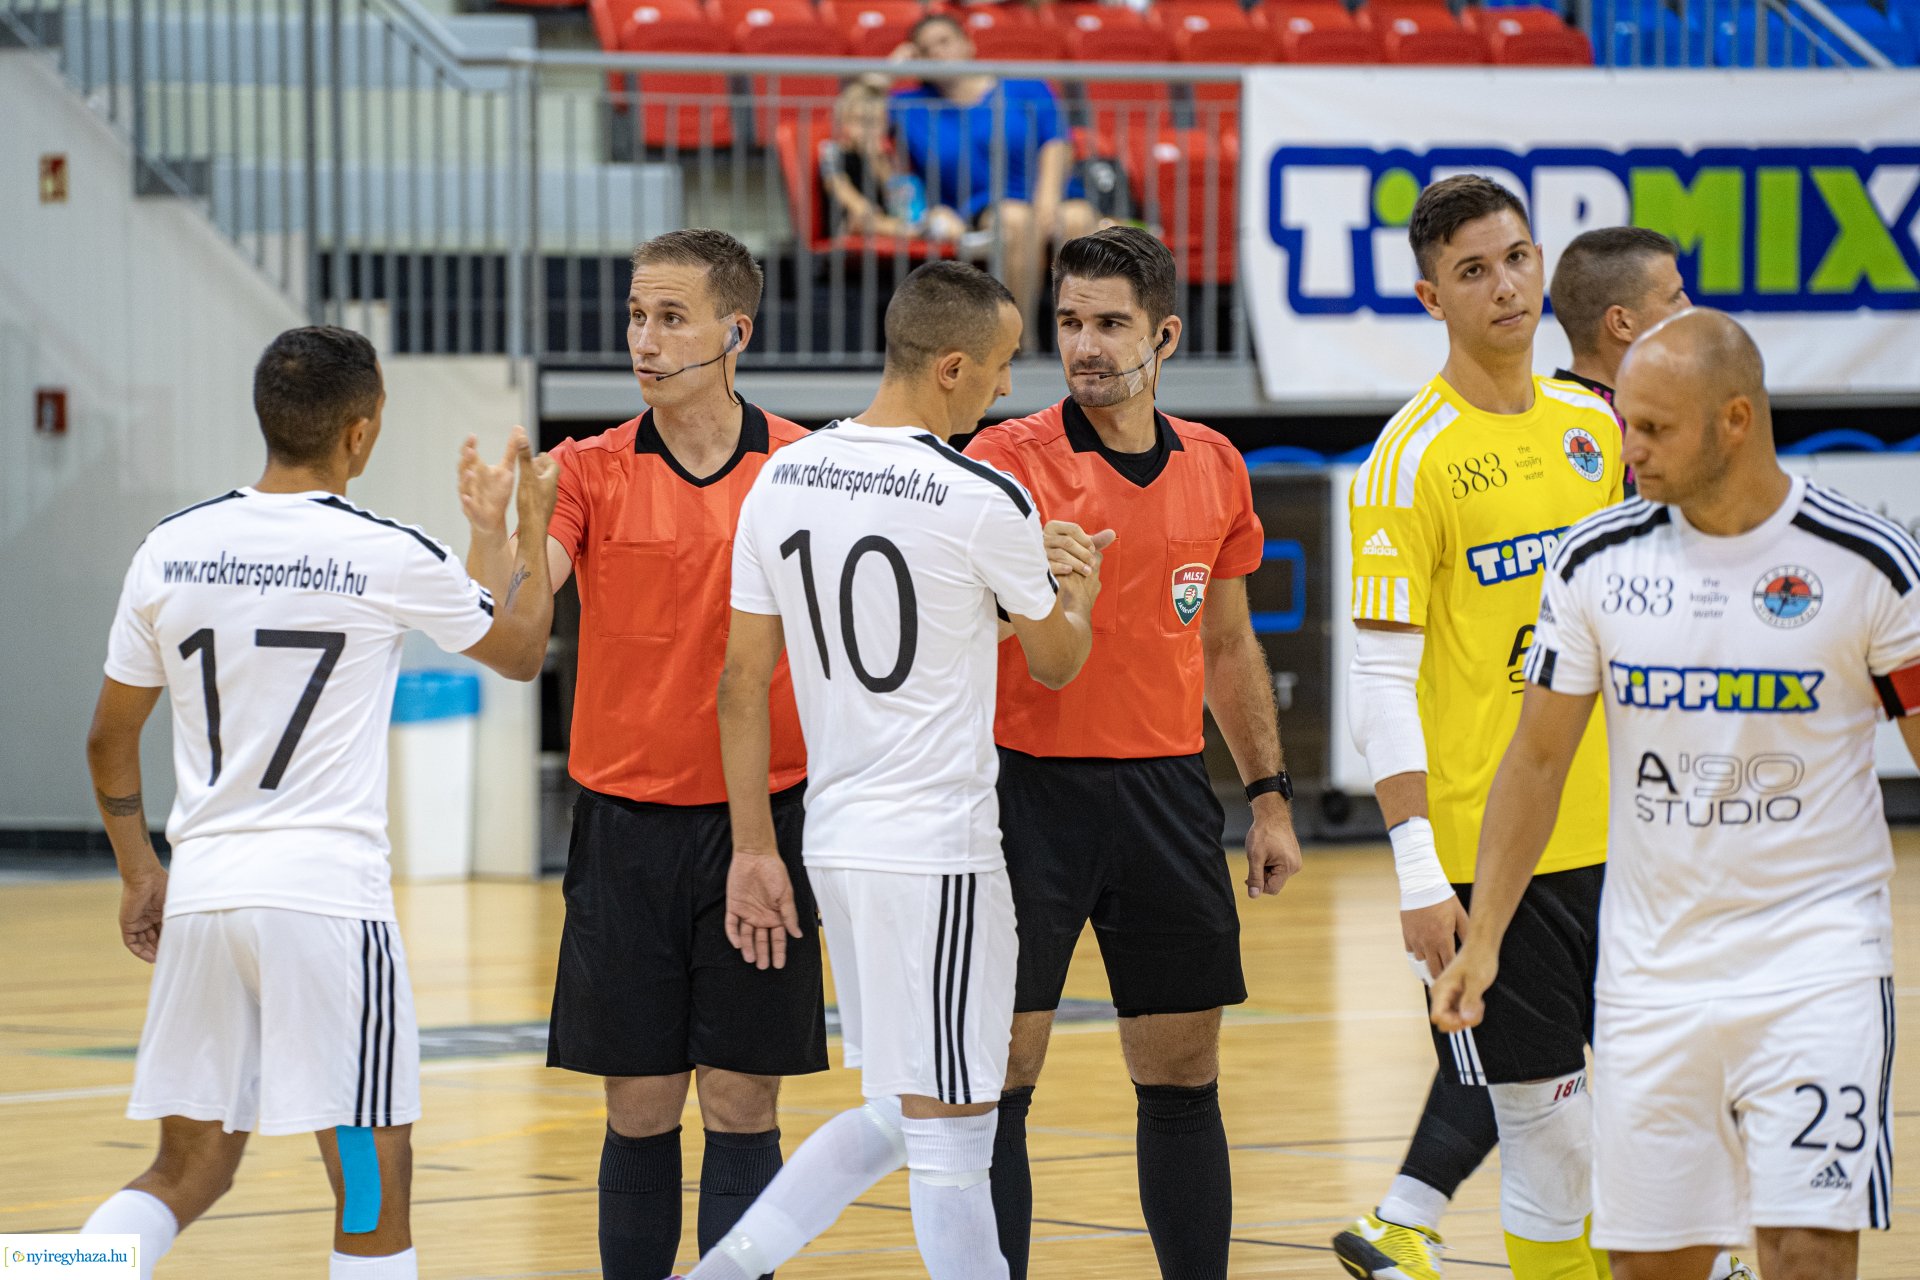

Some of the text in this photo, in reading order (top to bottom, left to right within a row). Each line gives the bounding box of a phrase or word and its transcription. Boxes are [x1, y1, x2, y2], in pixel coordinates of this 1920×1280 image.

[1280, 164, 1919, 296] TiPMIX
[1517, 445, 1531, 454] the
[770, 456, 950, 506] www.raktarsportbolt.hu
[1447, 452, 1508, 500] 383
[1524, 470, 1544, 481] water
[163, 550, 368, 596] www.raktarsportbolt.hu
[1362, 545, 1398, 557] adidas
[1183, 571, 1205, 581] MLSZ
[1601, 573, 1674, 617] 383
[780, 529, 918, 693] 10
[178, 628, 346, 790] 17
[1635, 795, 1802, 828] STUDIO
[1791, 1083, 1866, 1152] 23
[1810, 1179, 1853, 1190] adidas
